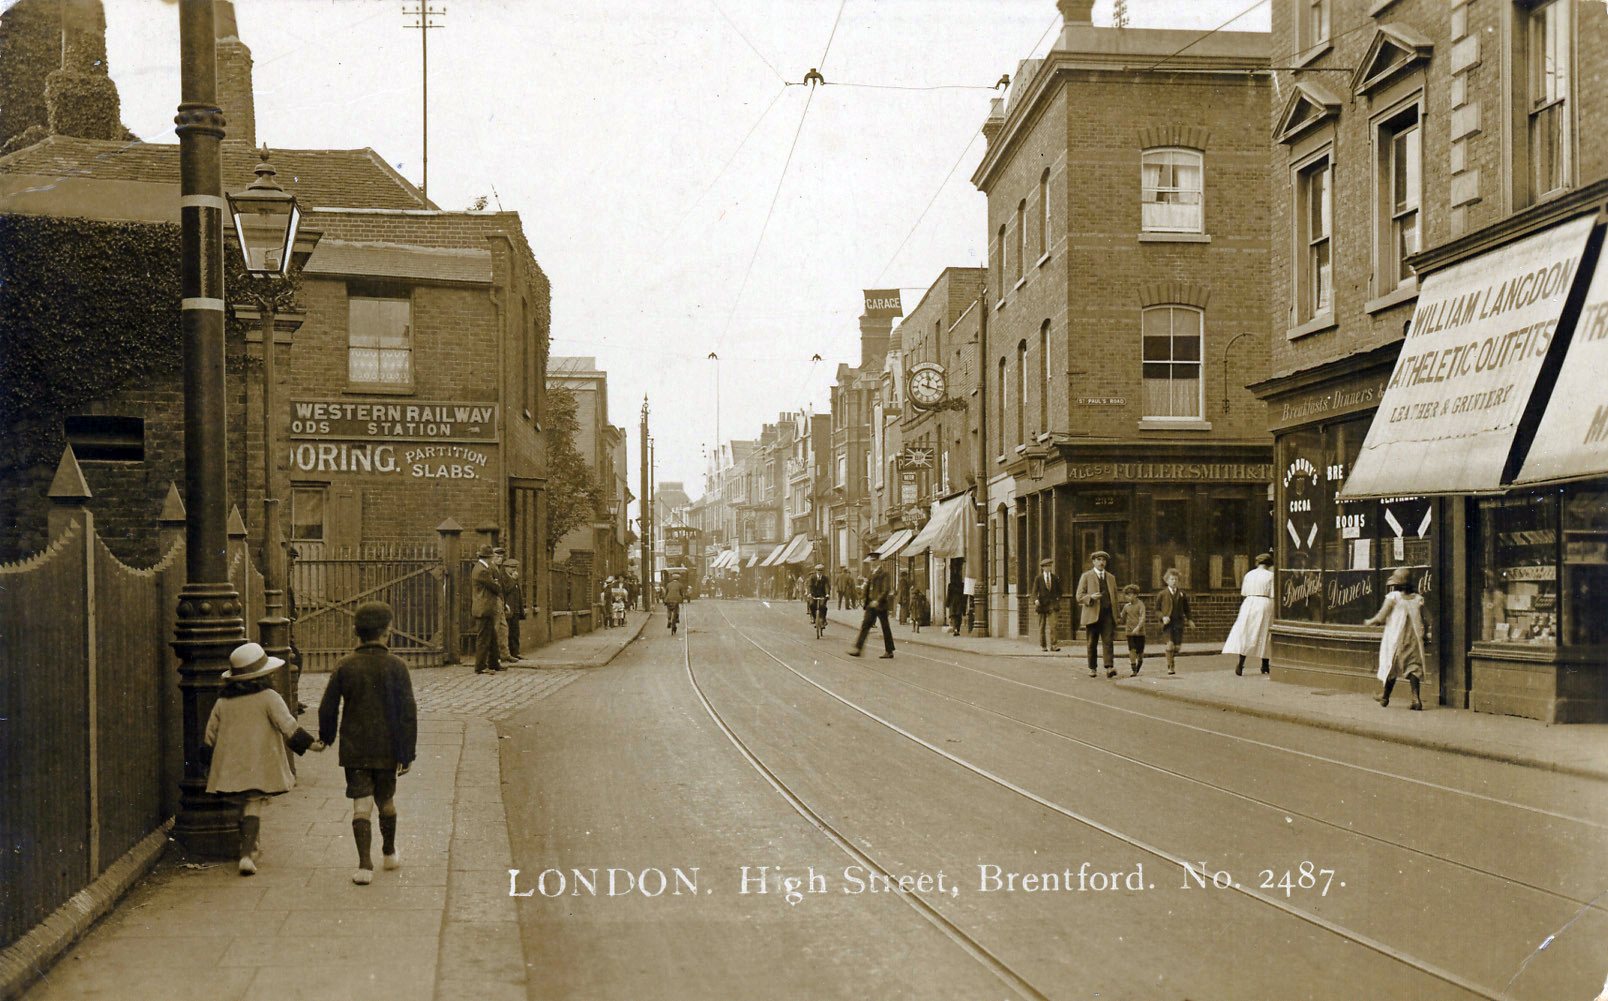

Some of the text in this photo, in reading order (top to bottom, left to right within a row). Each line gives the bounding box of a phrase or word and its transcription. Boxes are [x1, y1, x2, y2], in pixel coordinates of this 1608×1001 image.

[866, 298, 900, 309] GARAGE
[1412, 257, 1577, 338] WILLIAM LANGDON
[1389, 319, 1558, 389] ATHELETIC OUTFITS
[1332, 388, 1374, 409] Dinners
[296, 403, 492, 424] WESTERN RAILWAY
[291, 420, 450, 436] ODS STATION
[289, 443, 488, 473] ORING. PARTITION
[411, 463, 480, 479] SLABS.
[1283, 458, 1318, 488] CADBURY'S
[1289, 499, 1311, 513] COCOA
[1336, 514, 1366, 529] ROOMS
